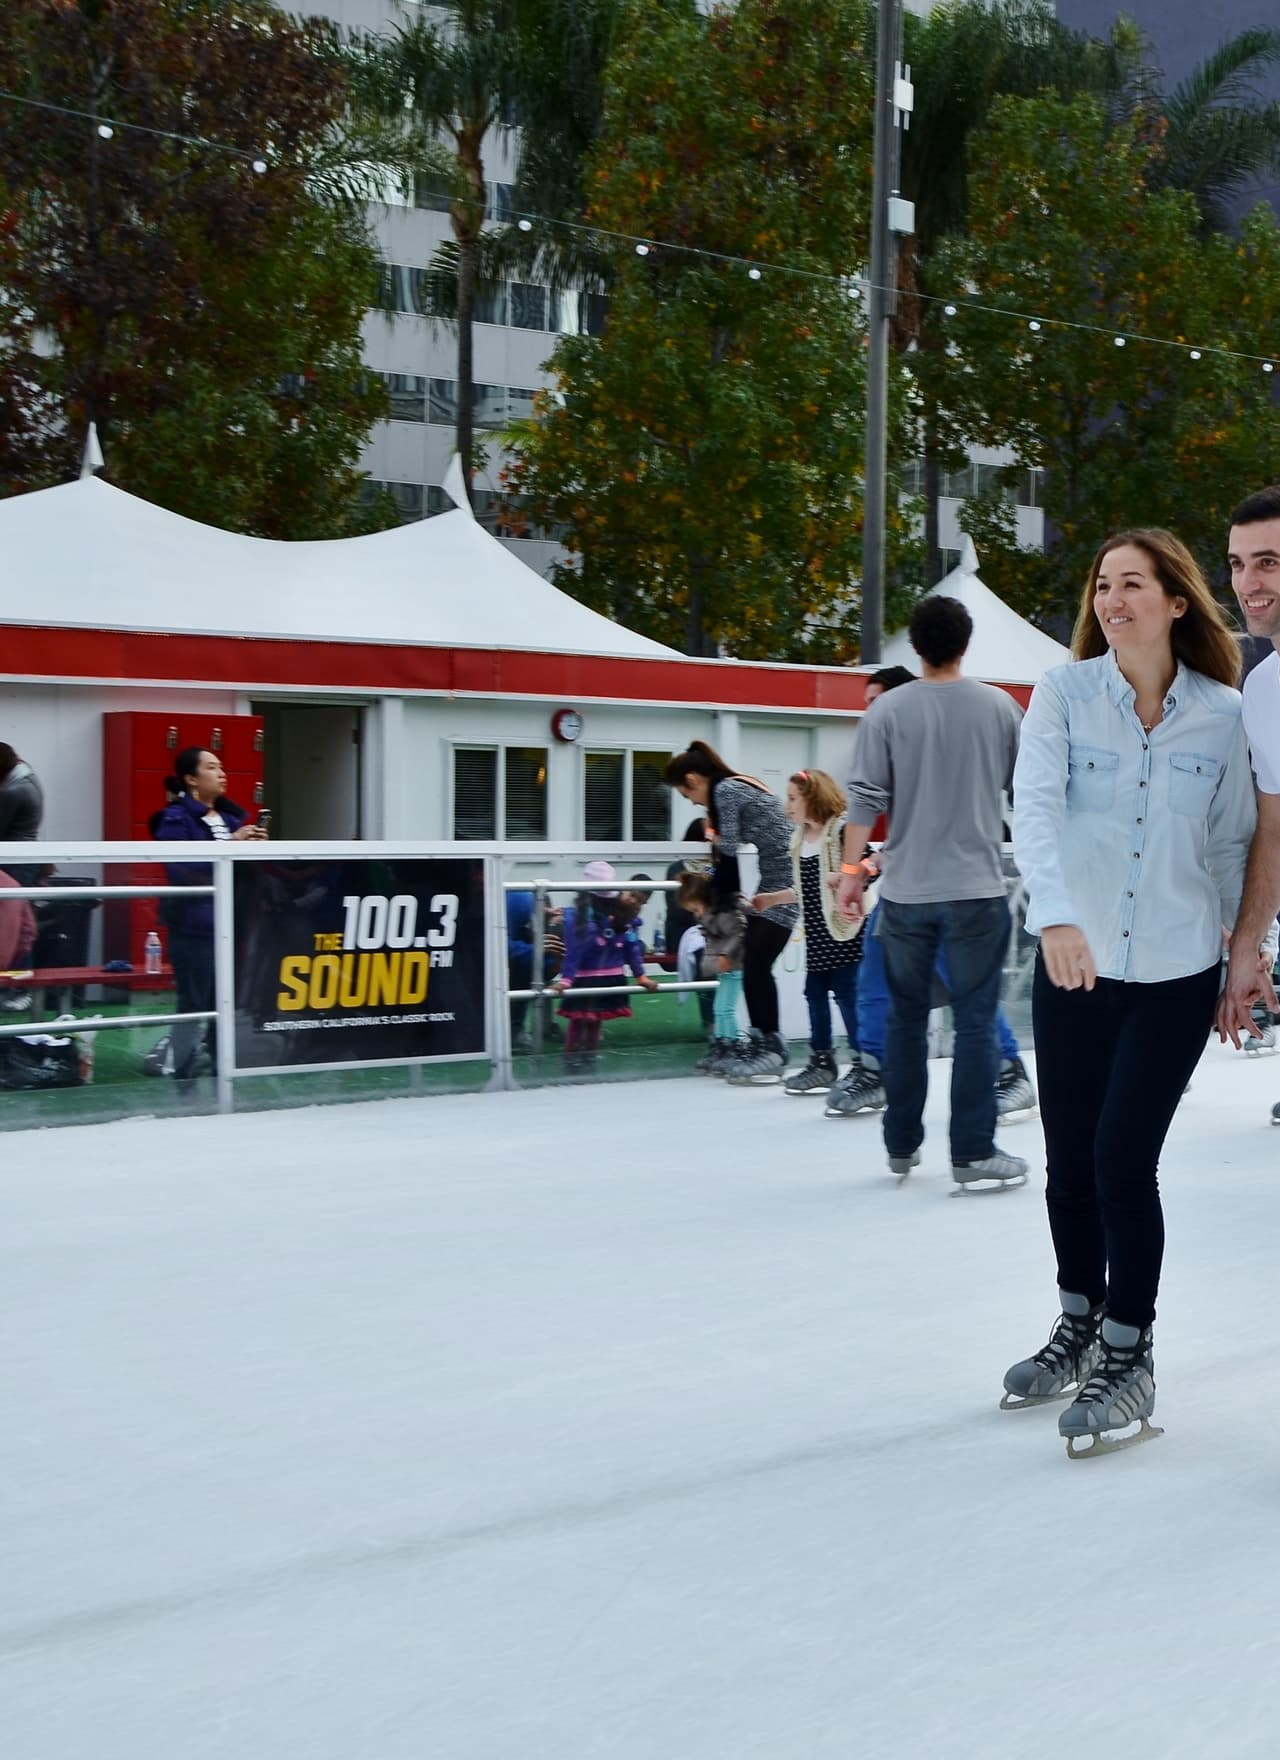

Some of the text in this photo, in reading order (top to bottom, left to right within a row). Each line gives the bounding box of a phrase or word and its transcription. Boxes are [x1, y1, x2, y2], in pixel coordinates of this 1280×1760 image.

[313, 894, 459, 952] THE 100.3
[277, 949, 455, 1011] SOUND FM
[263, 1019, 321, 1032] SOUTHERN
[390, 1012, 428, 1025] CLASSIC
[428, 1011, 457, 1023] ROCK
